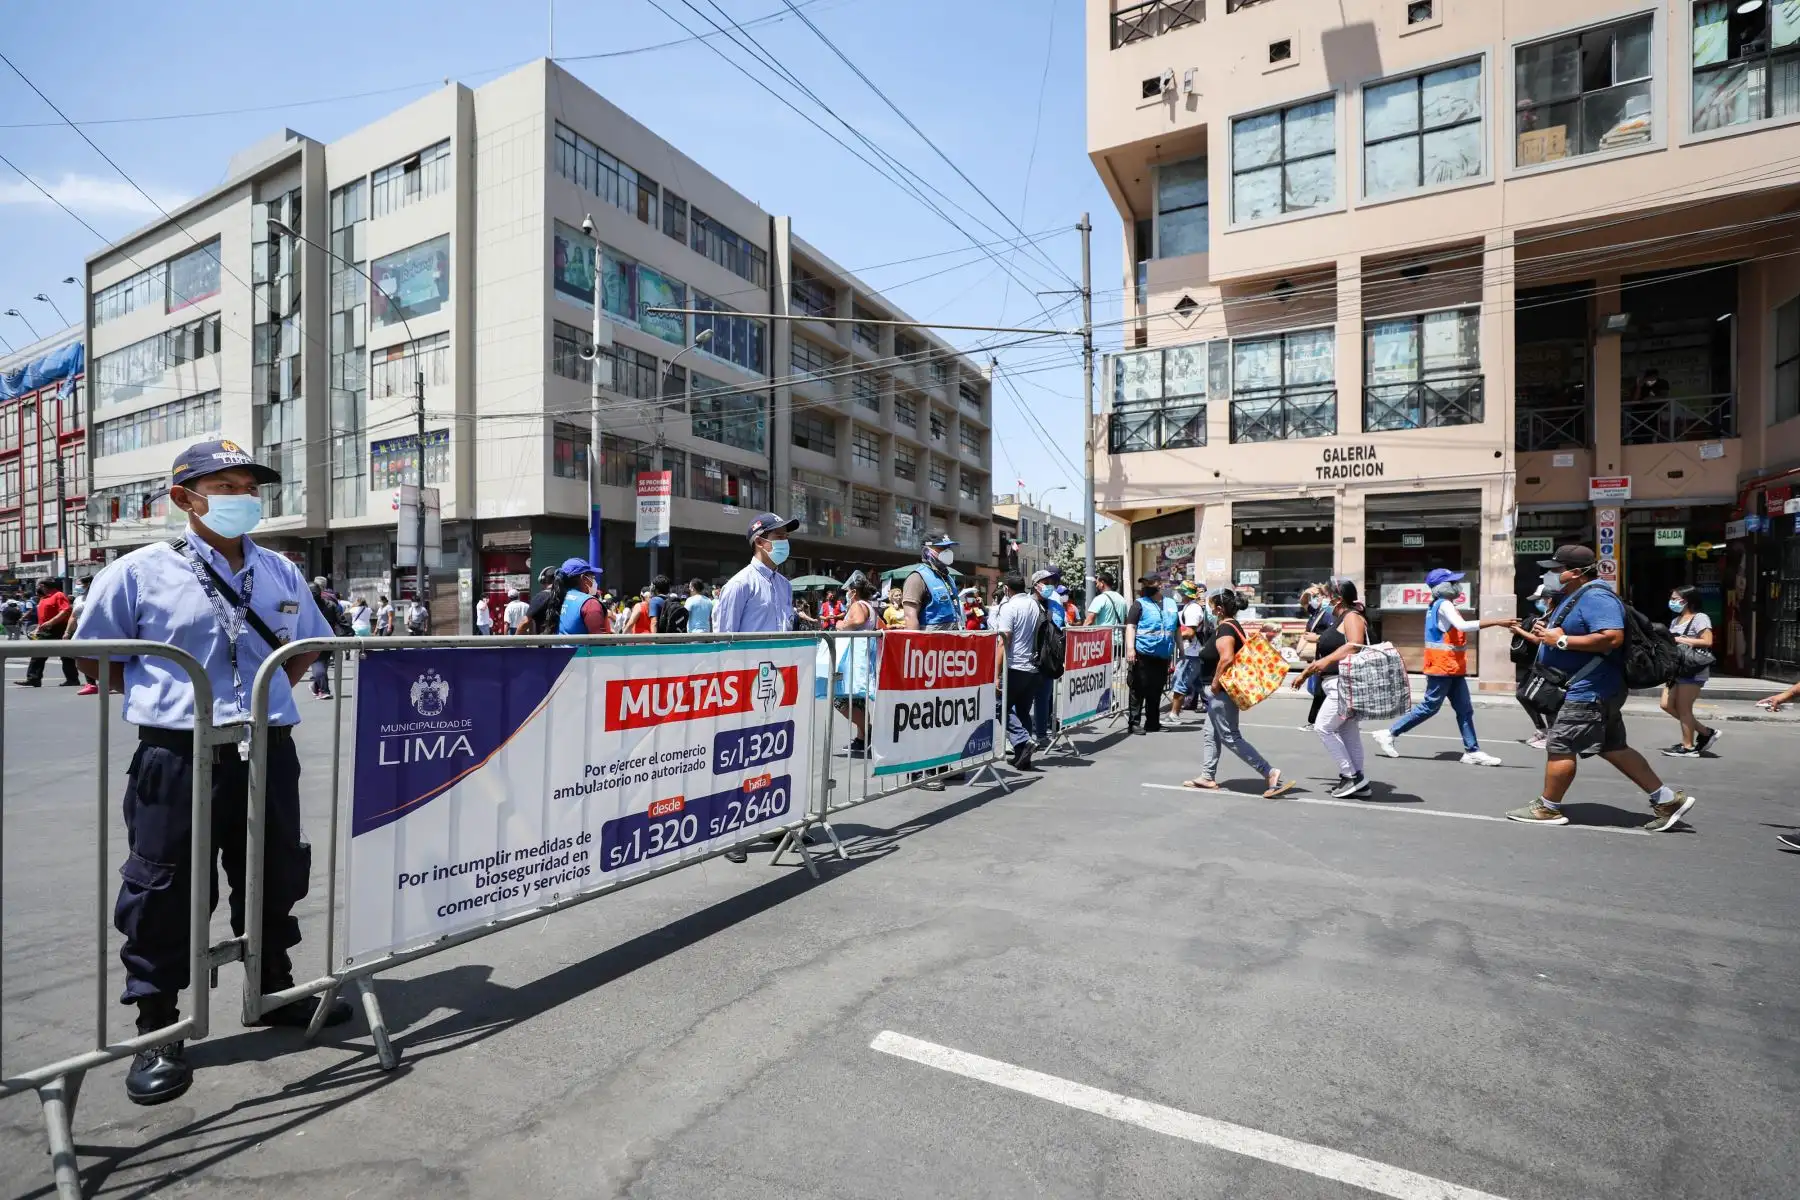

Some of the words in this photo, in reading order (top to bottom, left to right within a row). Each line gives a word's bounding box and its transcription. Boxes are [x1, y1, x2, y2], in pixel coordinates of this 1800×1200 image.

[1316, 462, 1384, 479] TRADICION
[1323, 445, 1376, 462] GALERIA
[1515, 540, 1551, 552] NGRESO
[1657, 530, 1682, 539] SALIDA
[1403, 589, 1467, 605] Pizs
[903, 639, 978, 688] Ingreso
[618, 675, 739, 721] MULTAS
[1069, 665, 1107, 704] peatonal
[380, 720, 460, 733] MUNICIPALIDAD
[461, 718, 472, 727] DE
[893, 687, 981, 743] peatonal
[379, 734, 475, 766] LIMA
[585, 763, 607, 778] Por
[609, 755, 647, 776] ejercer
[648, 751, 659, 766] el
[660, 743, 707, 763] comercio
[553, 775, 631, 800] ambulatorio
[634, 772, 649, 785] no
[651, 758, 706, 780] autorizado
[652, 799, 681, 816] desde
[398, 871, 428, 889] Por
[433, 849, 512, 881] incumplir
[514, 836, 573, 862] medidas
[576, 830, 592, 846] de
[475, 851, 569, 889] bioseguridad
[572, 849, 589, 863] en
[437, 885, 519, 917] comercios
[522, 882, 531, 897] y
[534, 863, 591, 891] servicios
